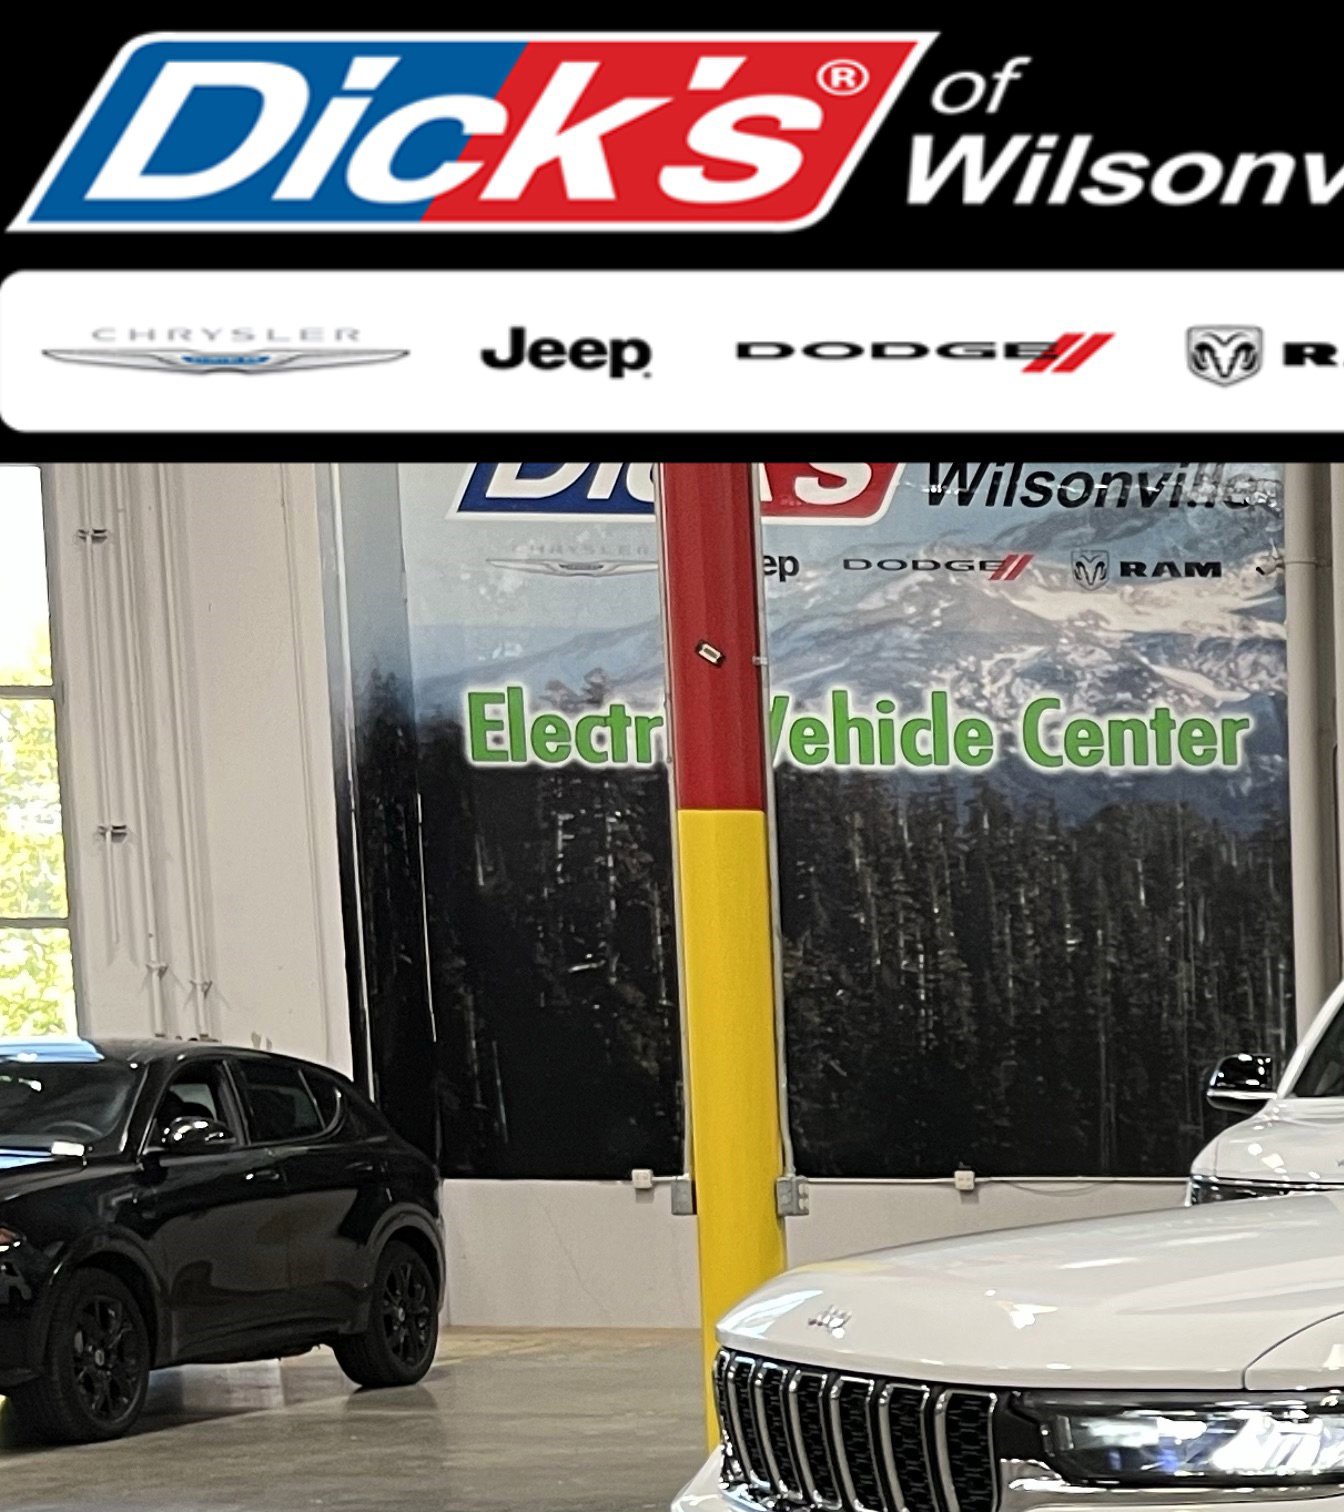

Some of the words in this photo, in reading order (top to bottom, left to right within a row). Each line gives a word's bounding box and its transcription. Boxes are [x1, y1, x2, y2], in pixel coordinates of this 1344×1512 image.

[763, 555, 799, 582] ep
[843, 559, 1003, 573] DODGE
[1119, 560, 1223, 579] RAM
[466, 686, 664, 764] Electr
[1022, 697, 1251, 767] Center
